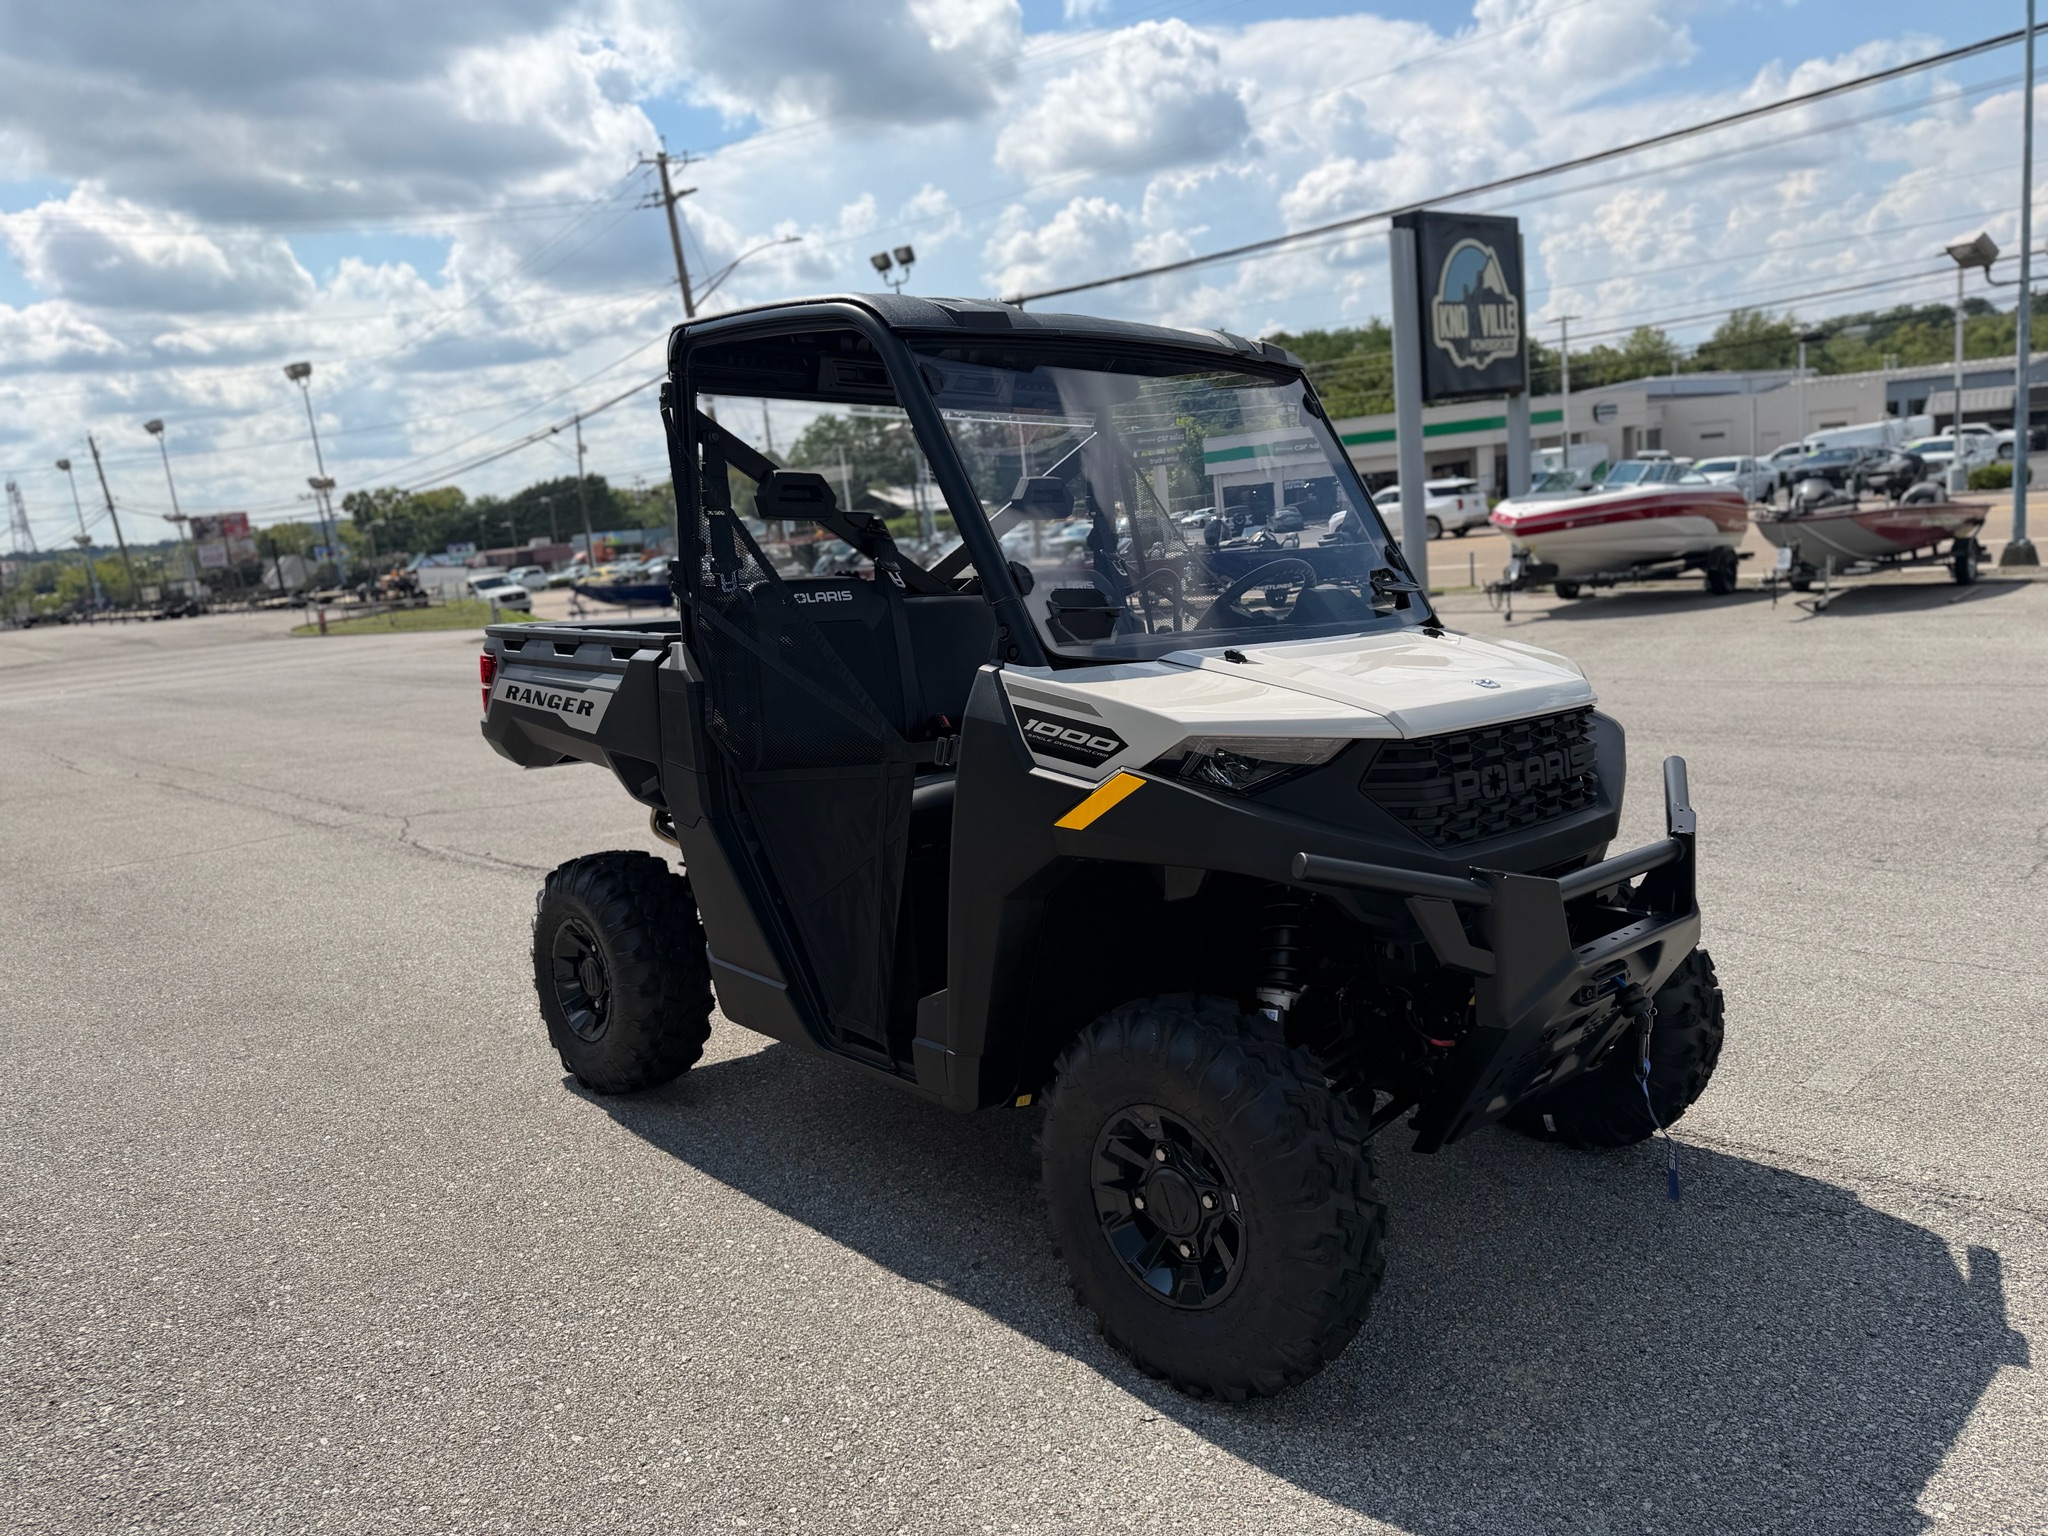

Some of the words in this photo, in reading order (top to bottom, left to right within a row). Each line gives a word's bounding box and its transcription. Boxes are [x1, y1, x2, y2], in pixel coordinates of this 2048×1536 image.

[1438, 304, 1516, 338] KNOVILLE
[793, 590, 853, 604] OLARIS
[505, 684, 595, 717] RANGER
[1023, 718, 1120, 752] 1000
[1027, 733, 1052, 743] SINGLE
[1054, 741, 1092, 753] OVERHEAD
[1453, 746, 1586, 805] POLARIS
